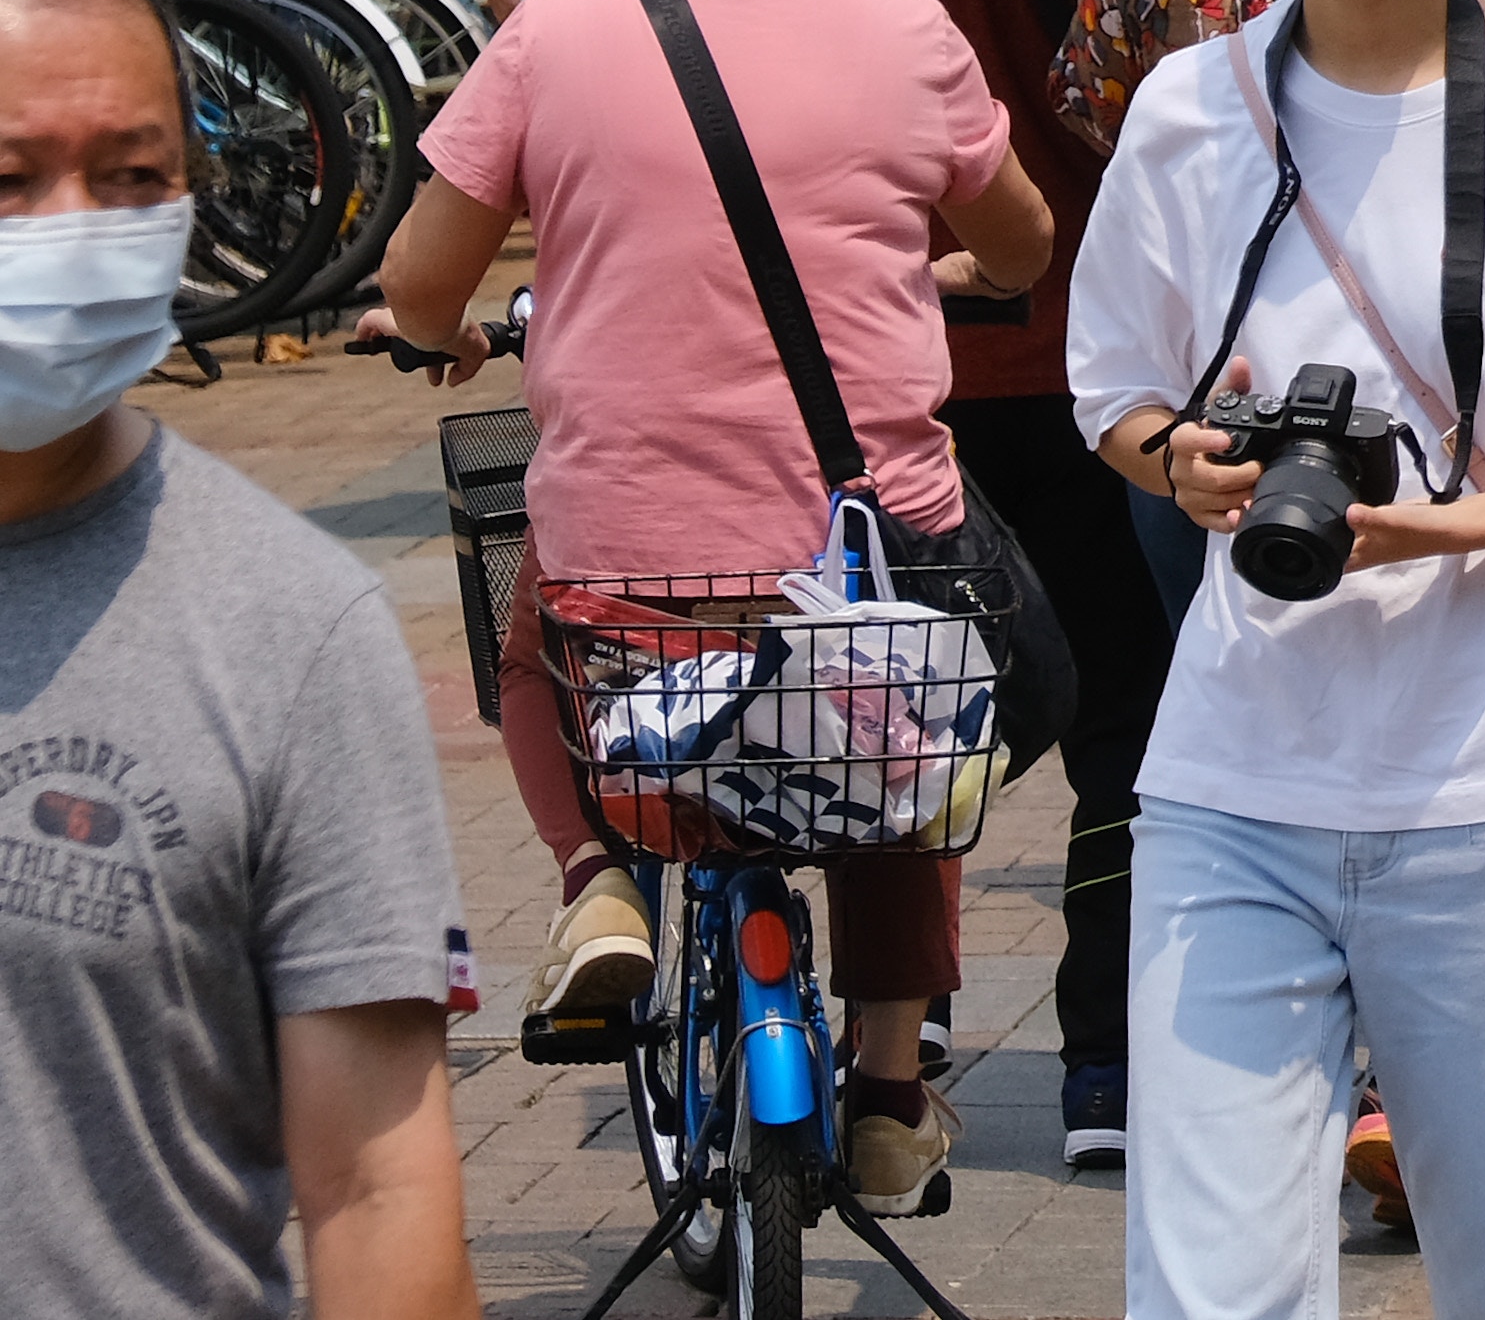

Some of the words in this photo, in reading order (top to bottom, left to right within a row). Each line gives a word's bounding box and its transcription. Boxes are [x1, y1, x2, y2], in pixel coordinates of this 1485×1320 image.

[1292, 415, 1329, 427] SONY
[130, 786, 188, 852] JPN
[0, 877, 132, 940] OLLEGE
